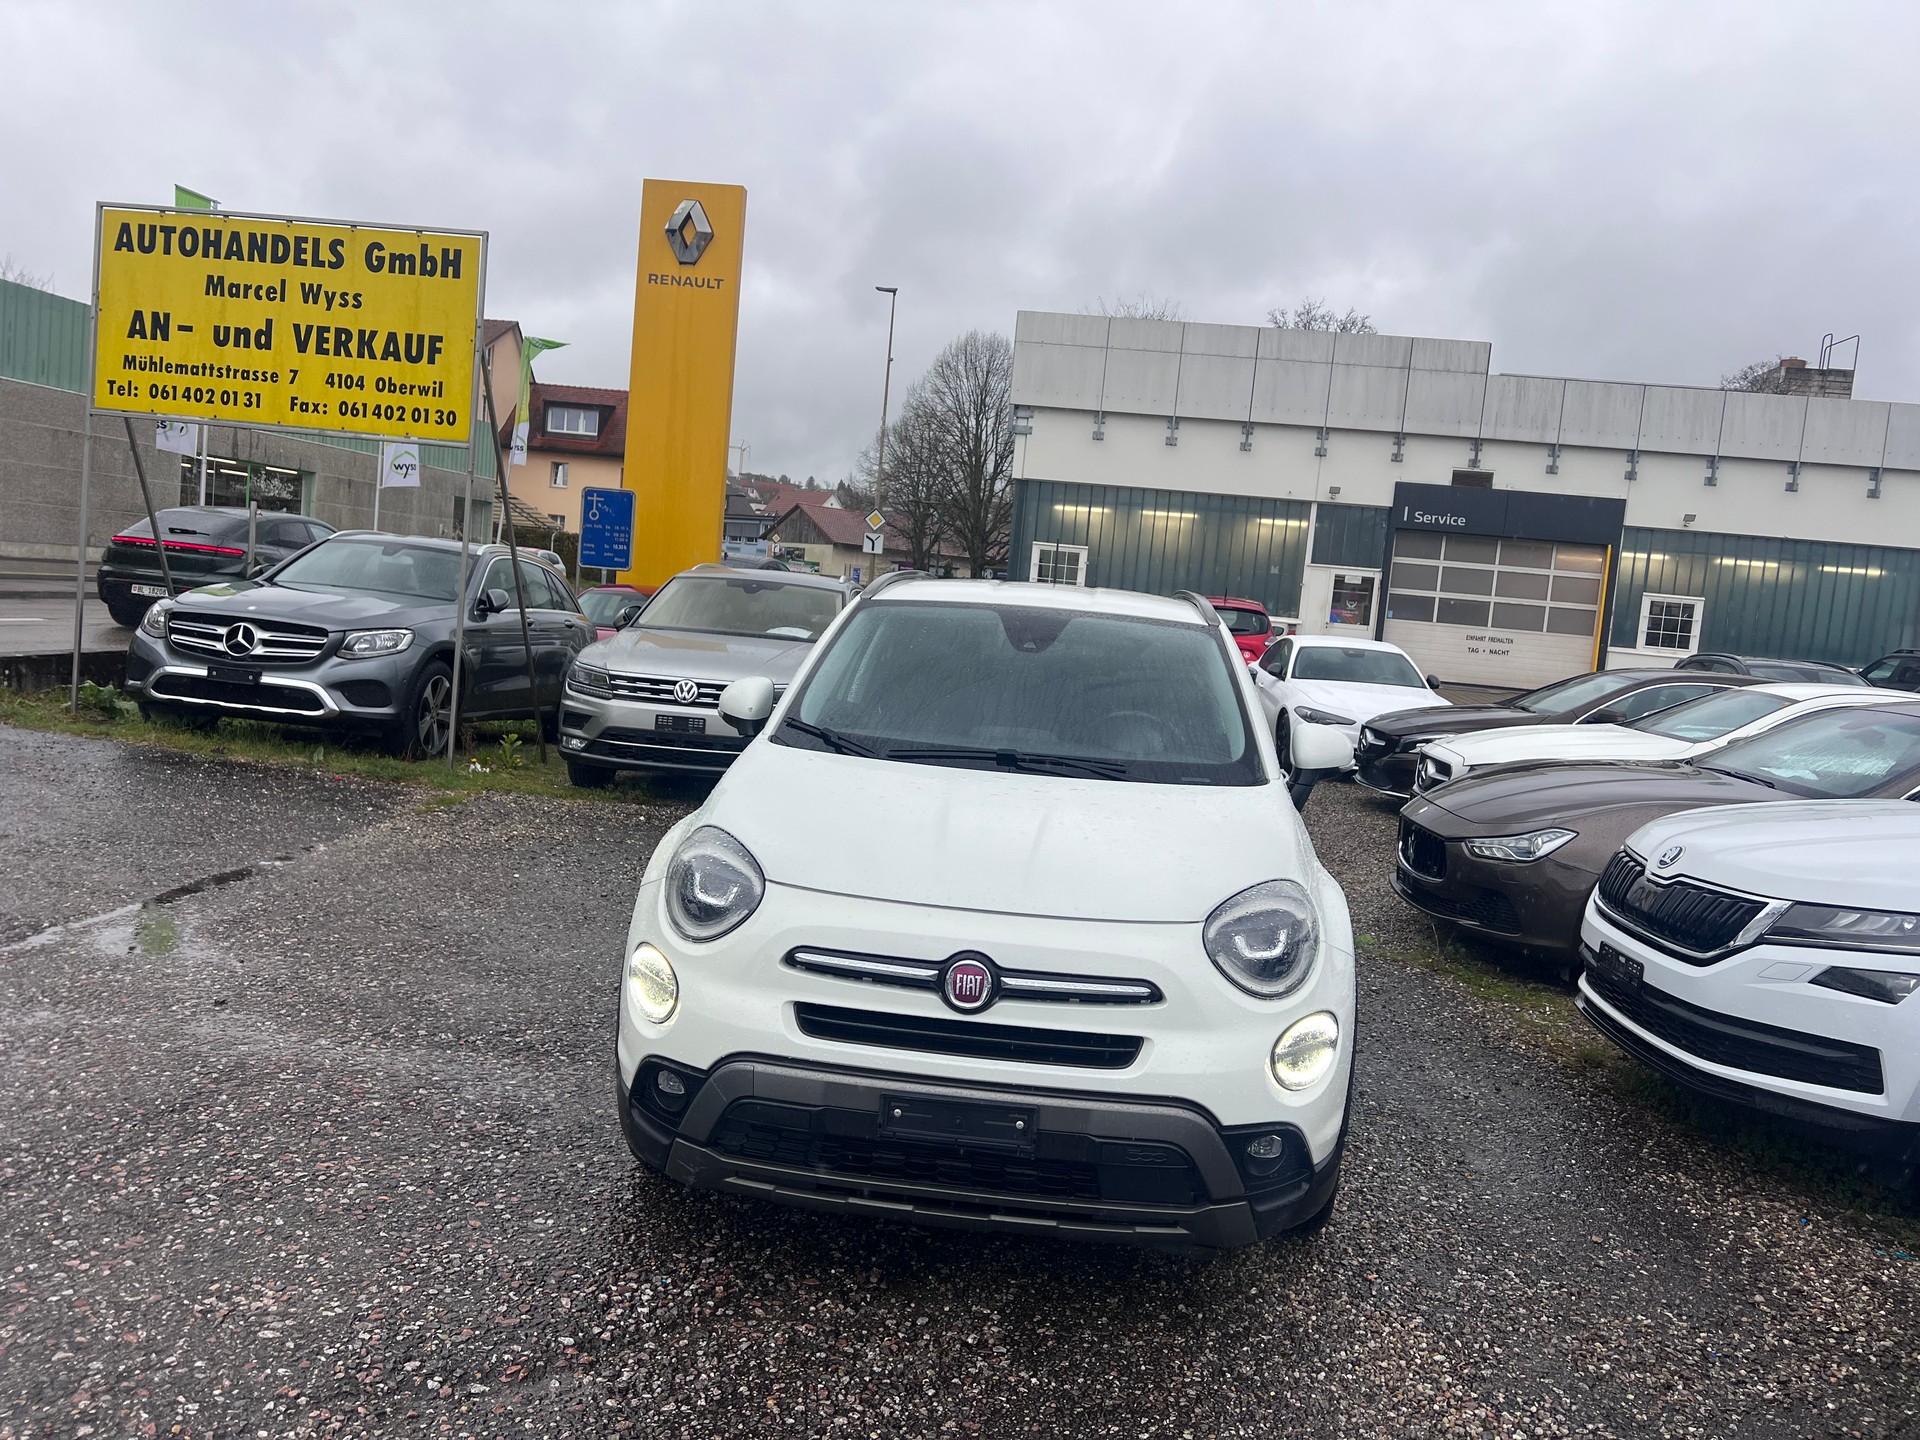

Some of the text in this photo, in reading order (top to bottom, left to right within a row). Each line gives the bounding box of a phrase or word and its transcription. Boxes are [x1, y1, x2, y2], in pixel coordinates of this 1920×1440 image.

[114, 223, 461, 279] AUTOHANDELS GmbH
[648, 273, 724, 290] RENAULT
[205, 275, 362, 311] Marcel Wyss
[213, 318, 273, 350] und
[293, 323, 443, 364] VERKAUF
[123, 355, 443, 397] Mühlemattstrasse 7 4104 Oberwil
[107, 380, 139, 397] Tel:
[290, 397, 328, 414] Fax:
[1414, 511, 1466, 526] Service
[1466, 634, 1514, 644] EINFAHRT FREIHALTEN
[1489, 648, 1510, 656] NACHT
[956, 973, 983, 996] FIAT
